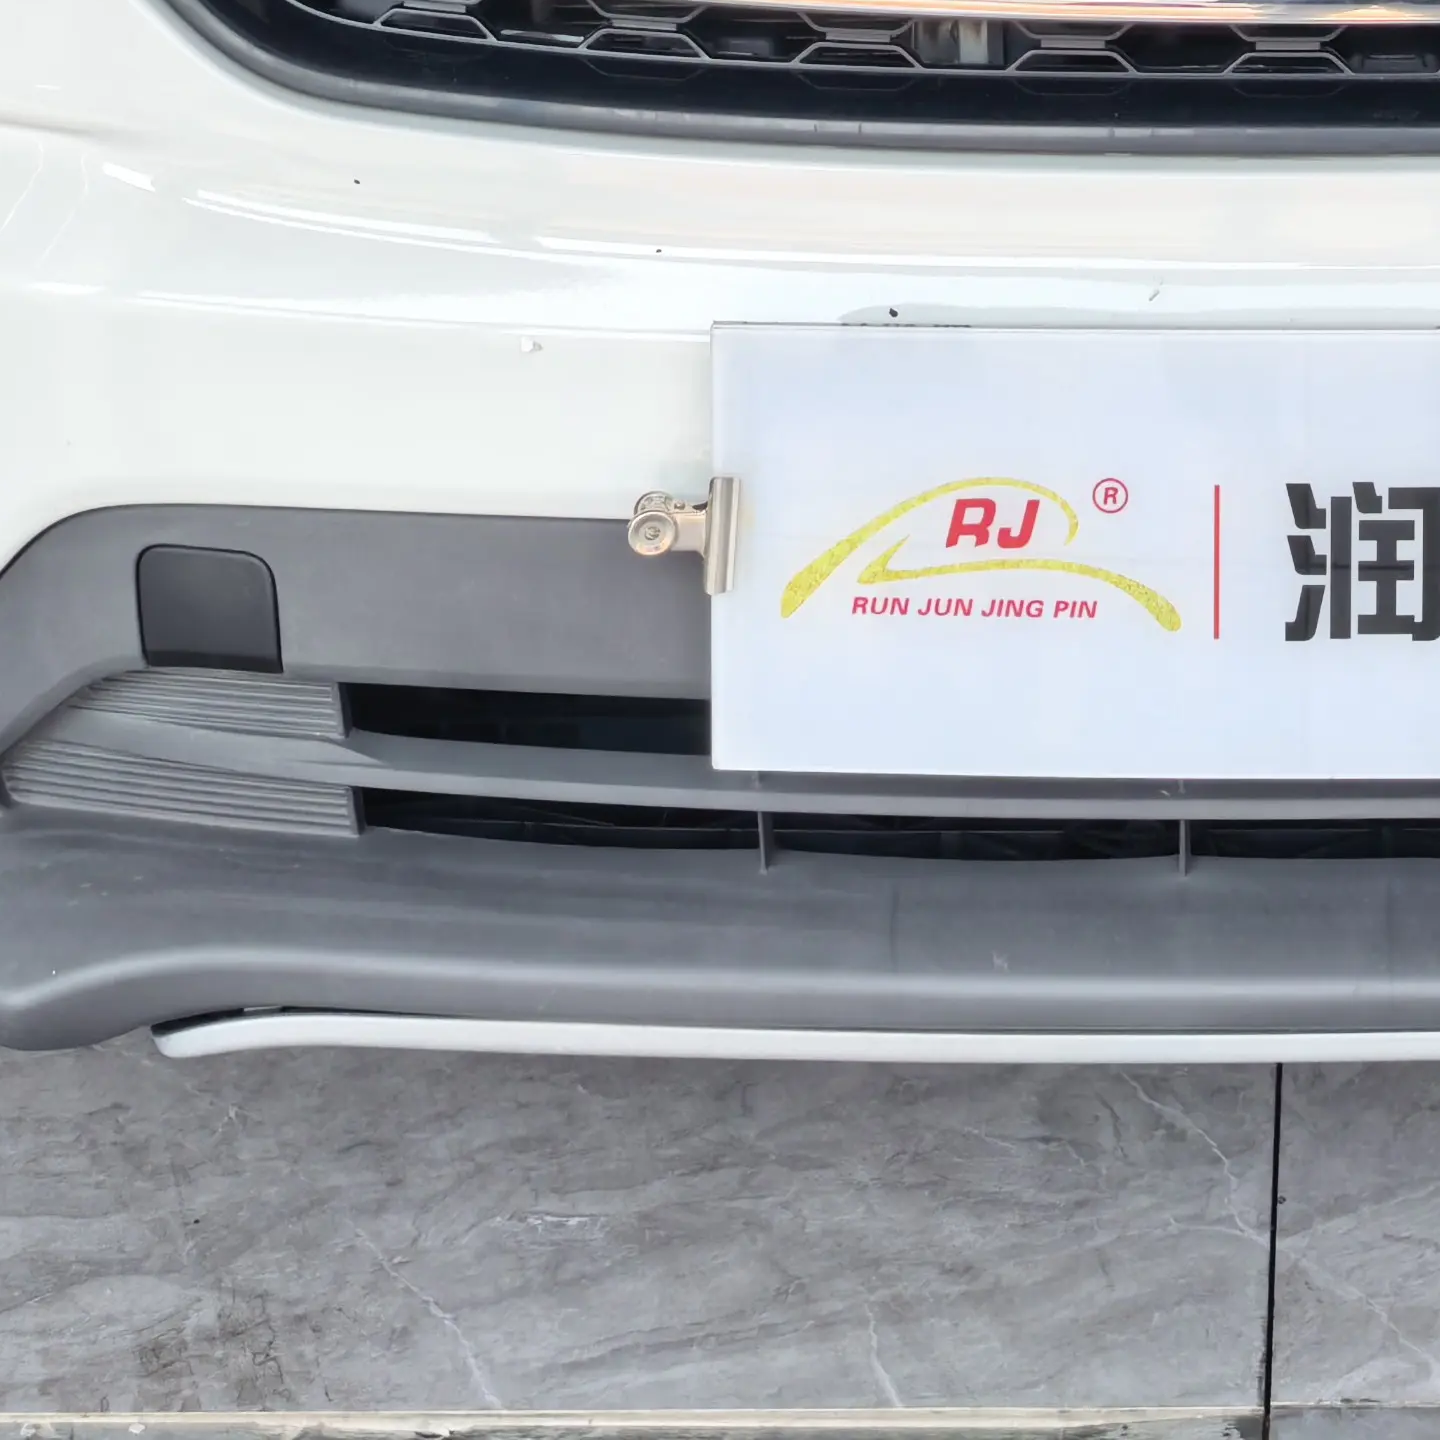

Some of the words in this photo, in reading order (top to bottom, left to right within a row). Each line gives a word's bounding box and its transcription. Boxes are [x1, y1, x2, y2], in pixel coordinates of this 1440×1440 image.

[944, 497, 1041, 549] RJ
[851, 595, 910, 616] RUN
[917, 597, 974, 617] JUN
[980, 598, 1045, 619] JING
[1053, 600, 1098, 619] PIN
